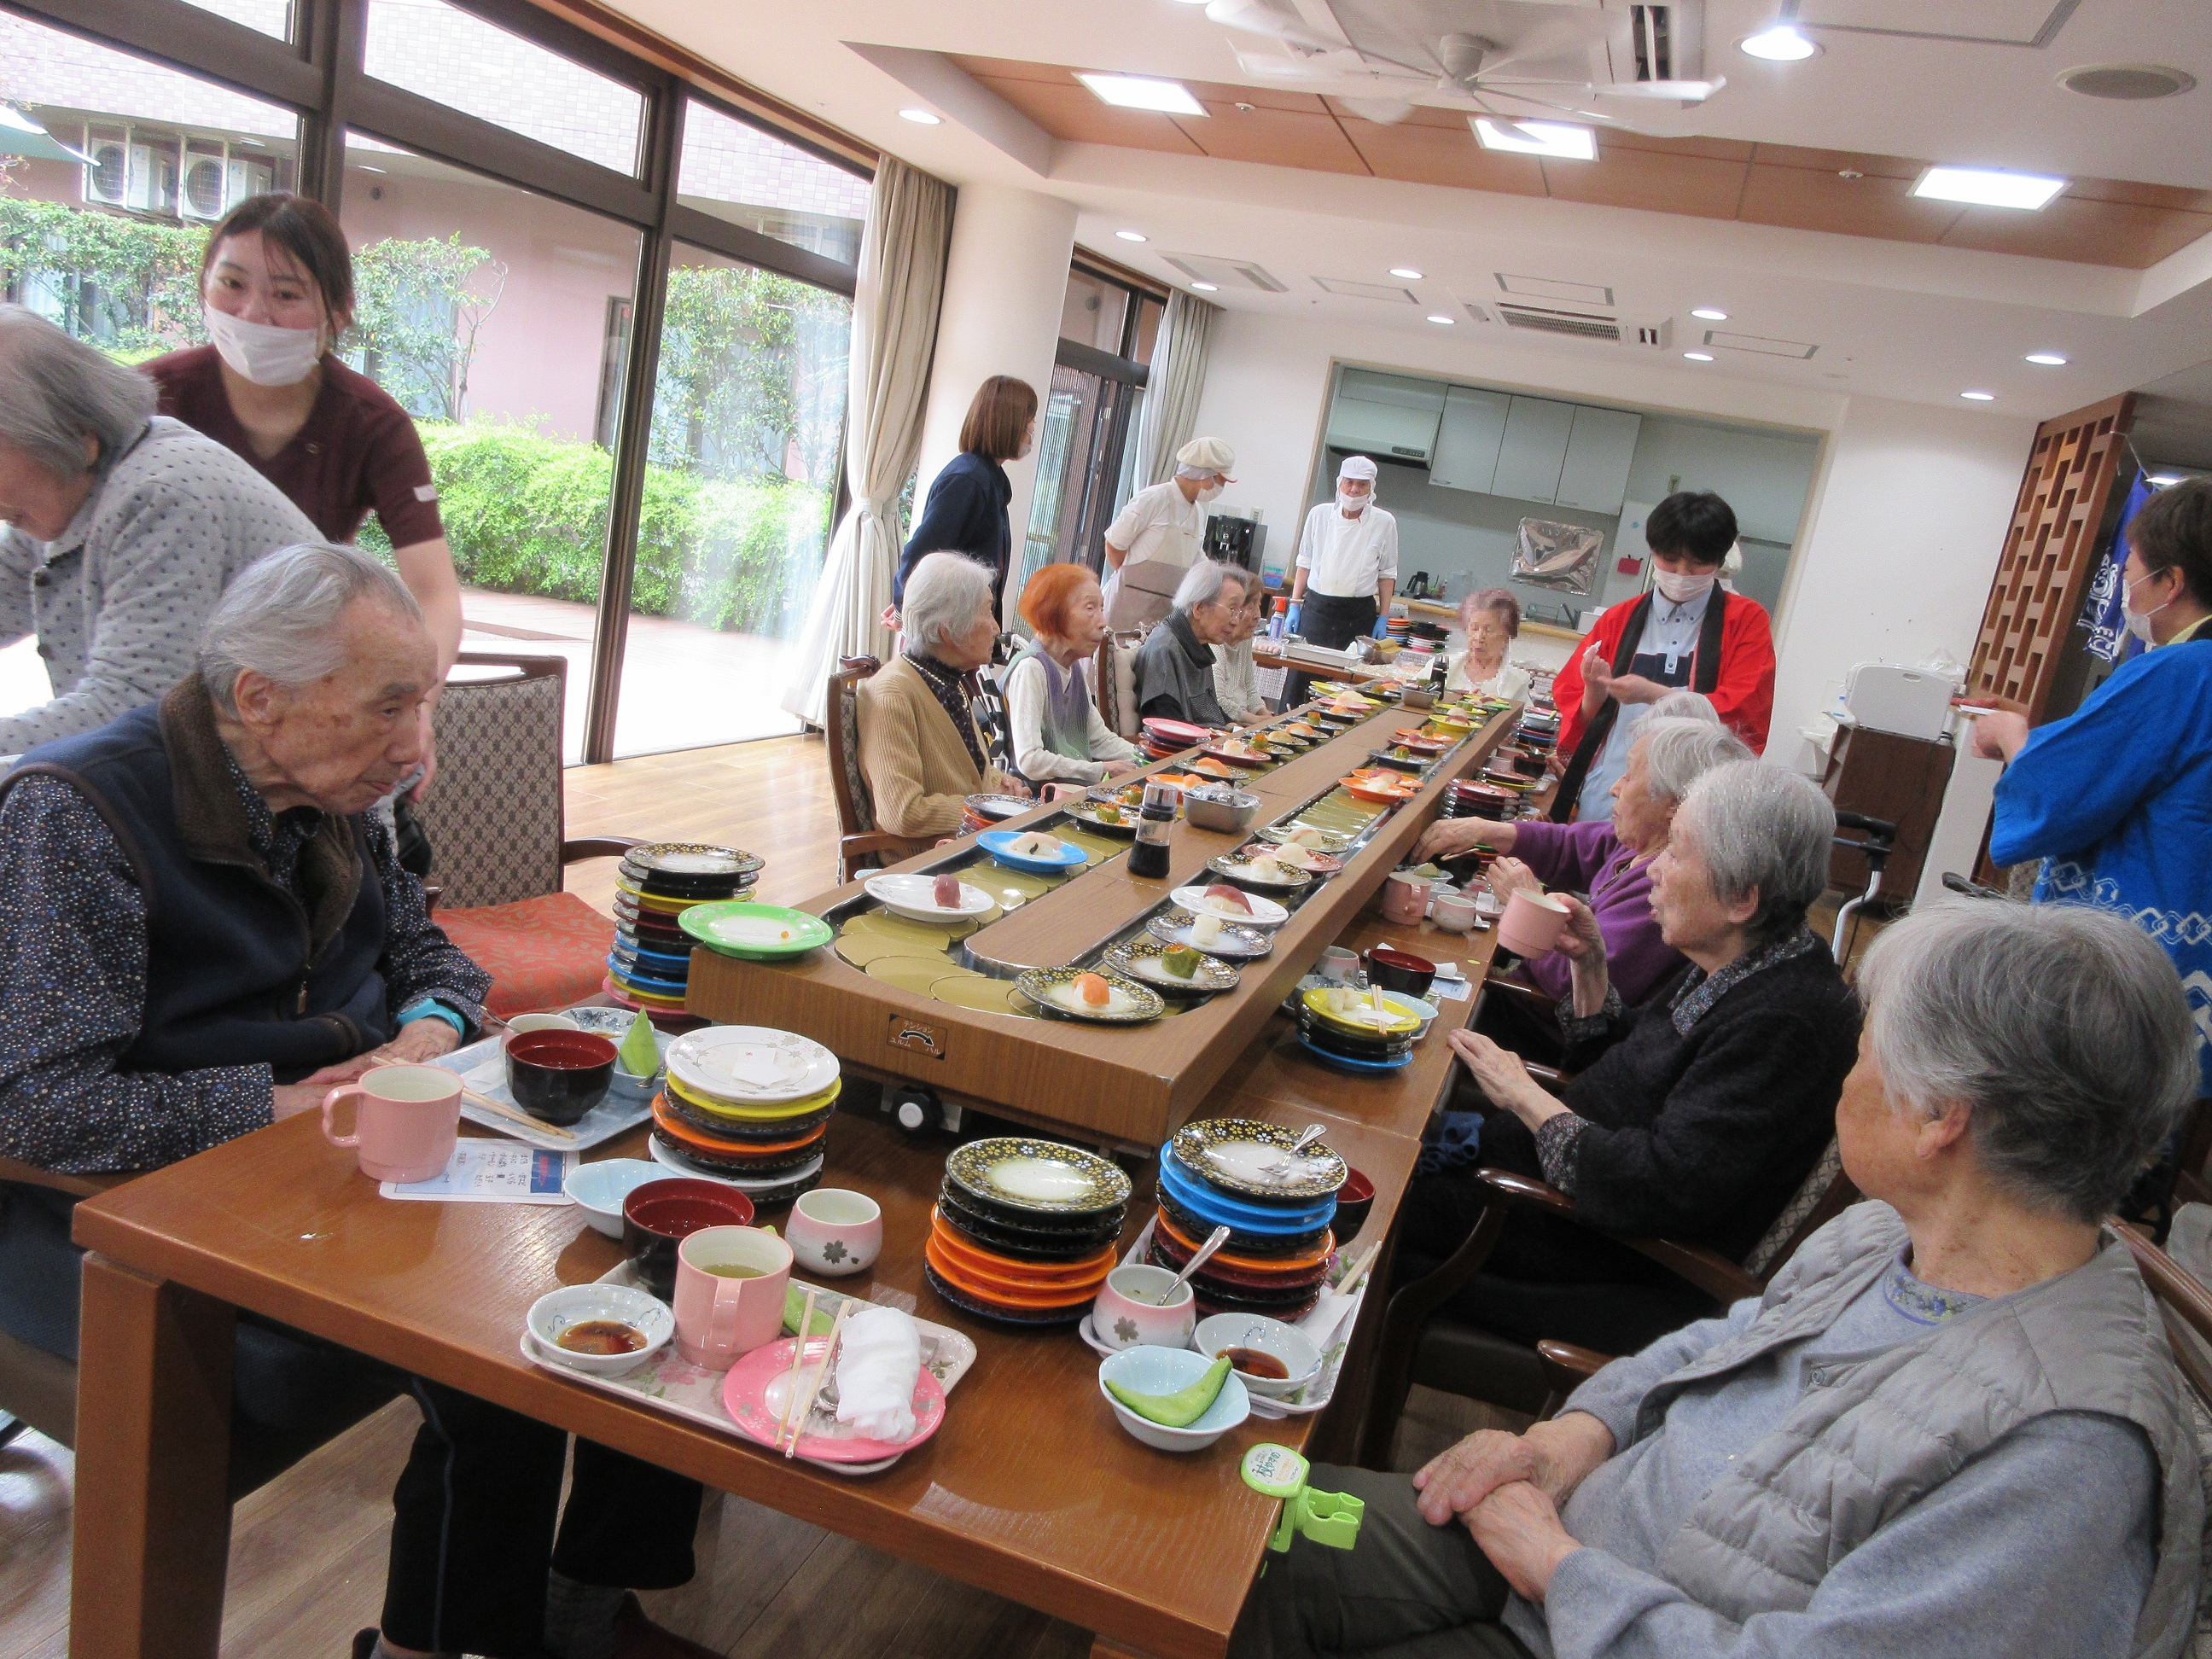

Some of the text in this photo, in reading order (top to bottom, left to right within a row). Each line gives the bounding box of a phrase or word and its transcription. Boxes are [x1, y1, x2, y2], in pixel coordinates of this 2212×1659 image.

[904, 1020, 934, 1033] テンション
[890, 1037, 911, 1048] ユルム
[926, 1046, 941, 1055] ハル
[1252, 1452, 1281, 1477] 杖やすめ
